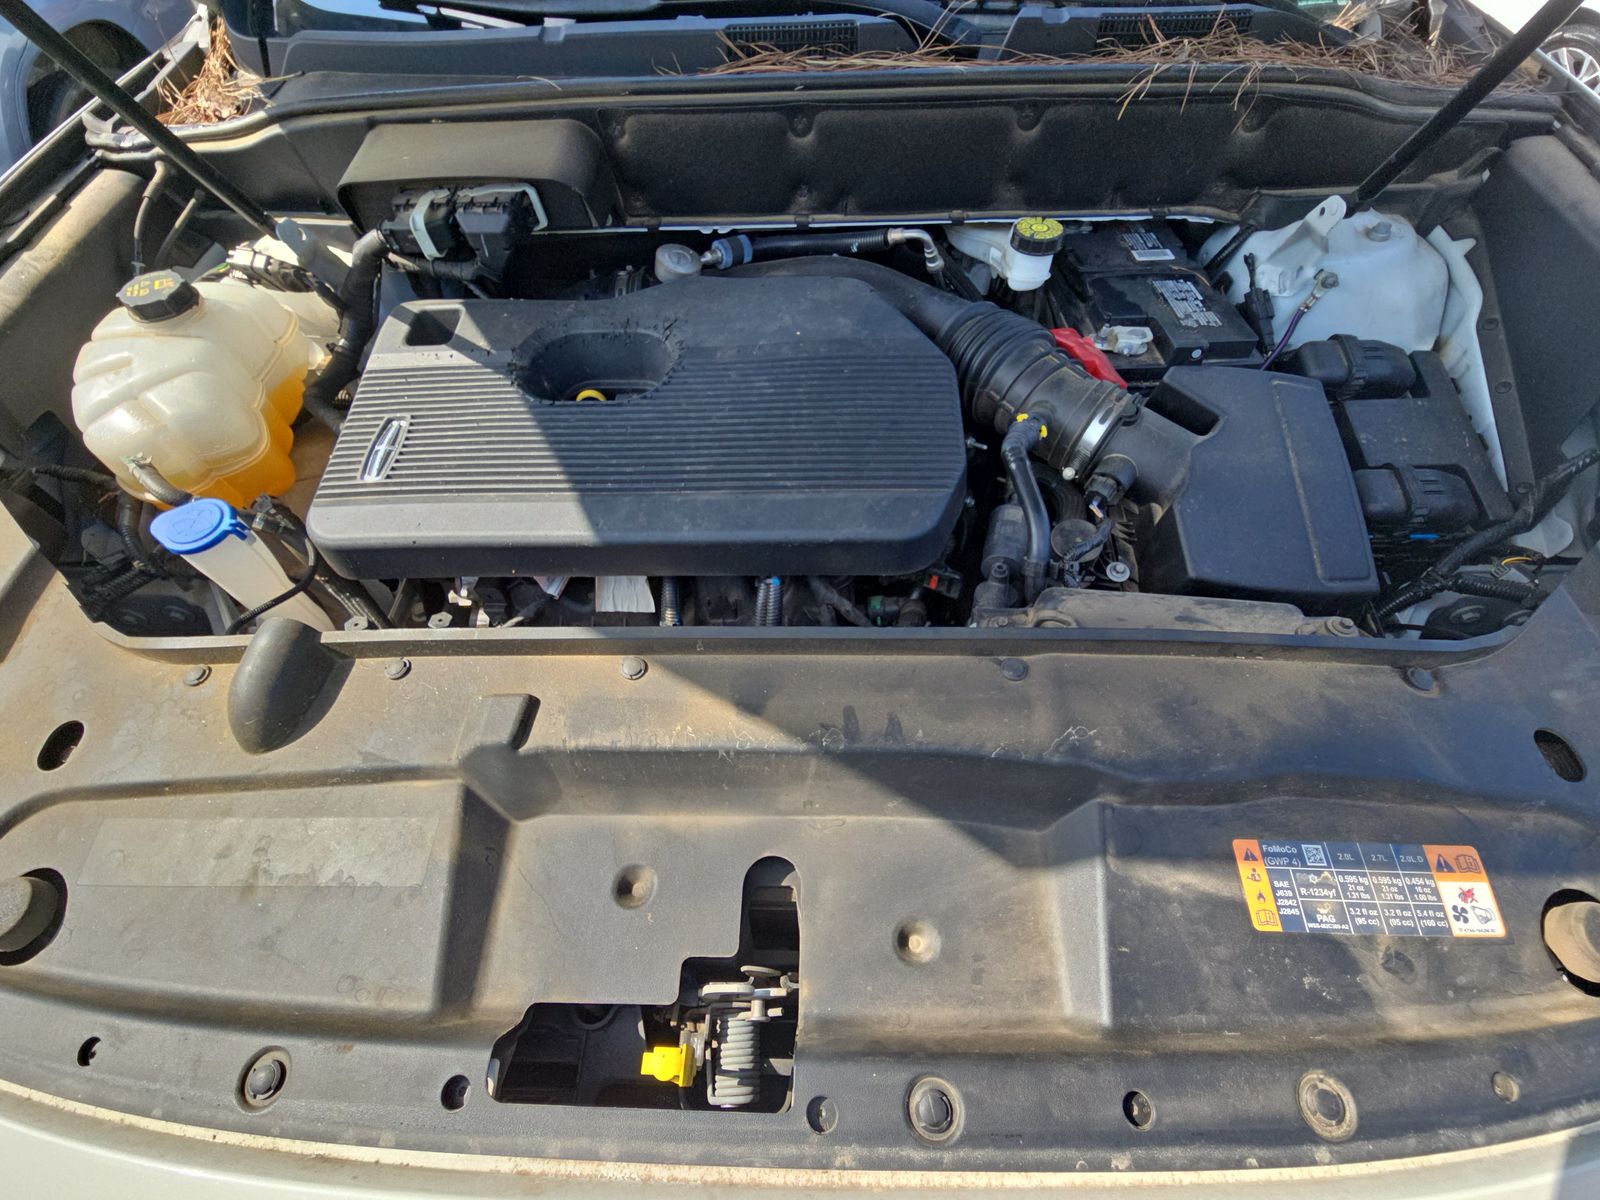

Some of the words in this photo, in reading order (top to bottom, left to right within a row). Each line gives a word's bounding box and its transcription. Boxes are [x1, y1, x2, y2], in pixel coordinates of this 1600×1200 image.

[1262, 845, 1297, 853] FoMoCo
[1337, 852, 1355, 861] 2.0L
[1370, 854, 1388, 862] 2.7L
[1400, 855, 1416, 863] 2.0L
[1264, 856, 1289, 867] (GWP
[1292, 857, 1301, 868] 4)
[1273, 880, 1290, 888] SAE
[1338, 874, 1358, 883] 0.595
[1359, 875, 1369, 886] kg
[1371, 875, 1390, 884] 0.595
[1392, 876, 1402, 886] kg
[1405, 876, 1424, 886] 0.454
[1425, 877, 1435, 887] kg
[1275, 889, 1293, 897] J639
[1300, 887, 1336, 898] R-1234yf
[1360, 892, 1370, 900] lbs
[1349, 907, 1361, 915] 3.2
[1384, 908, 1395, 916] 3.2
[1316, 914, 1336, 923] PAG
[1355, 917, 1367, 926] (95
[1368, 918, 1380, 927] cc)
[1389, 918, 1402, 927] (95
[1402, 919, 1414, 928] cc)
[1420, 919, 1436, 928] (160
[1437, 920, 1449, 928] cc)
